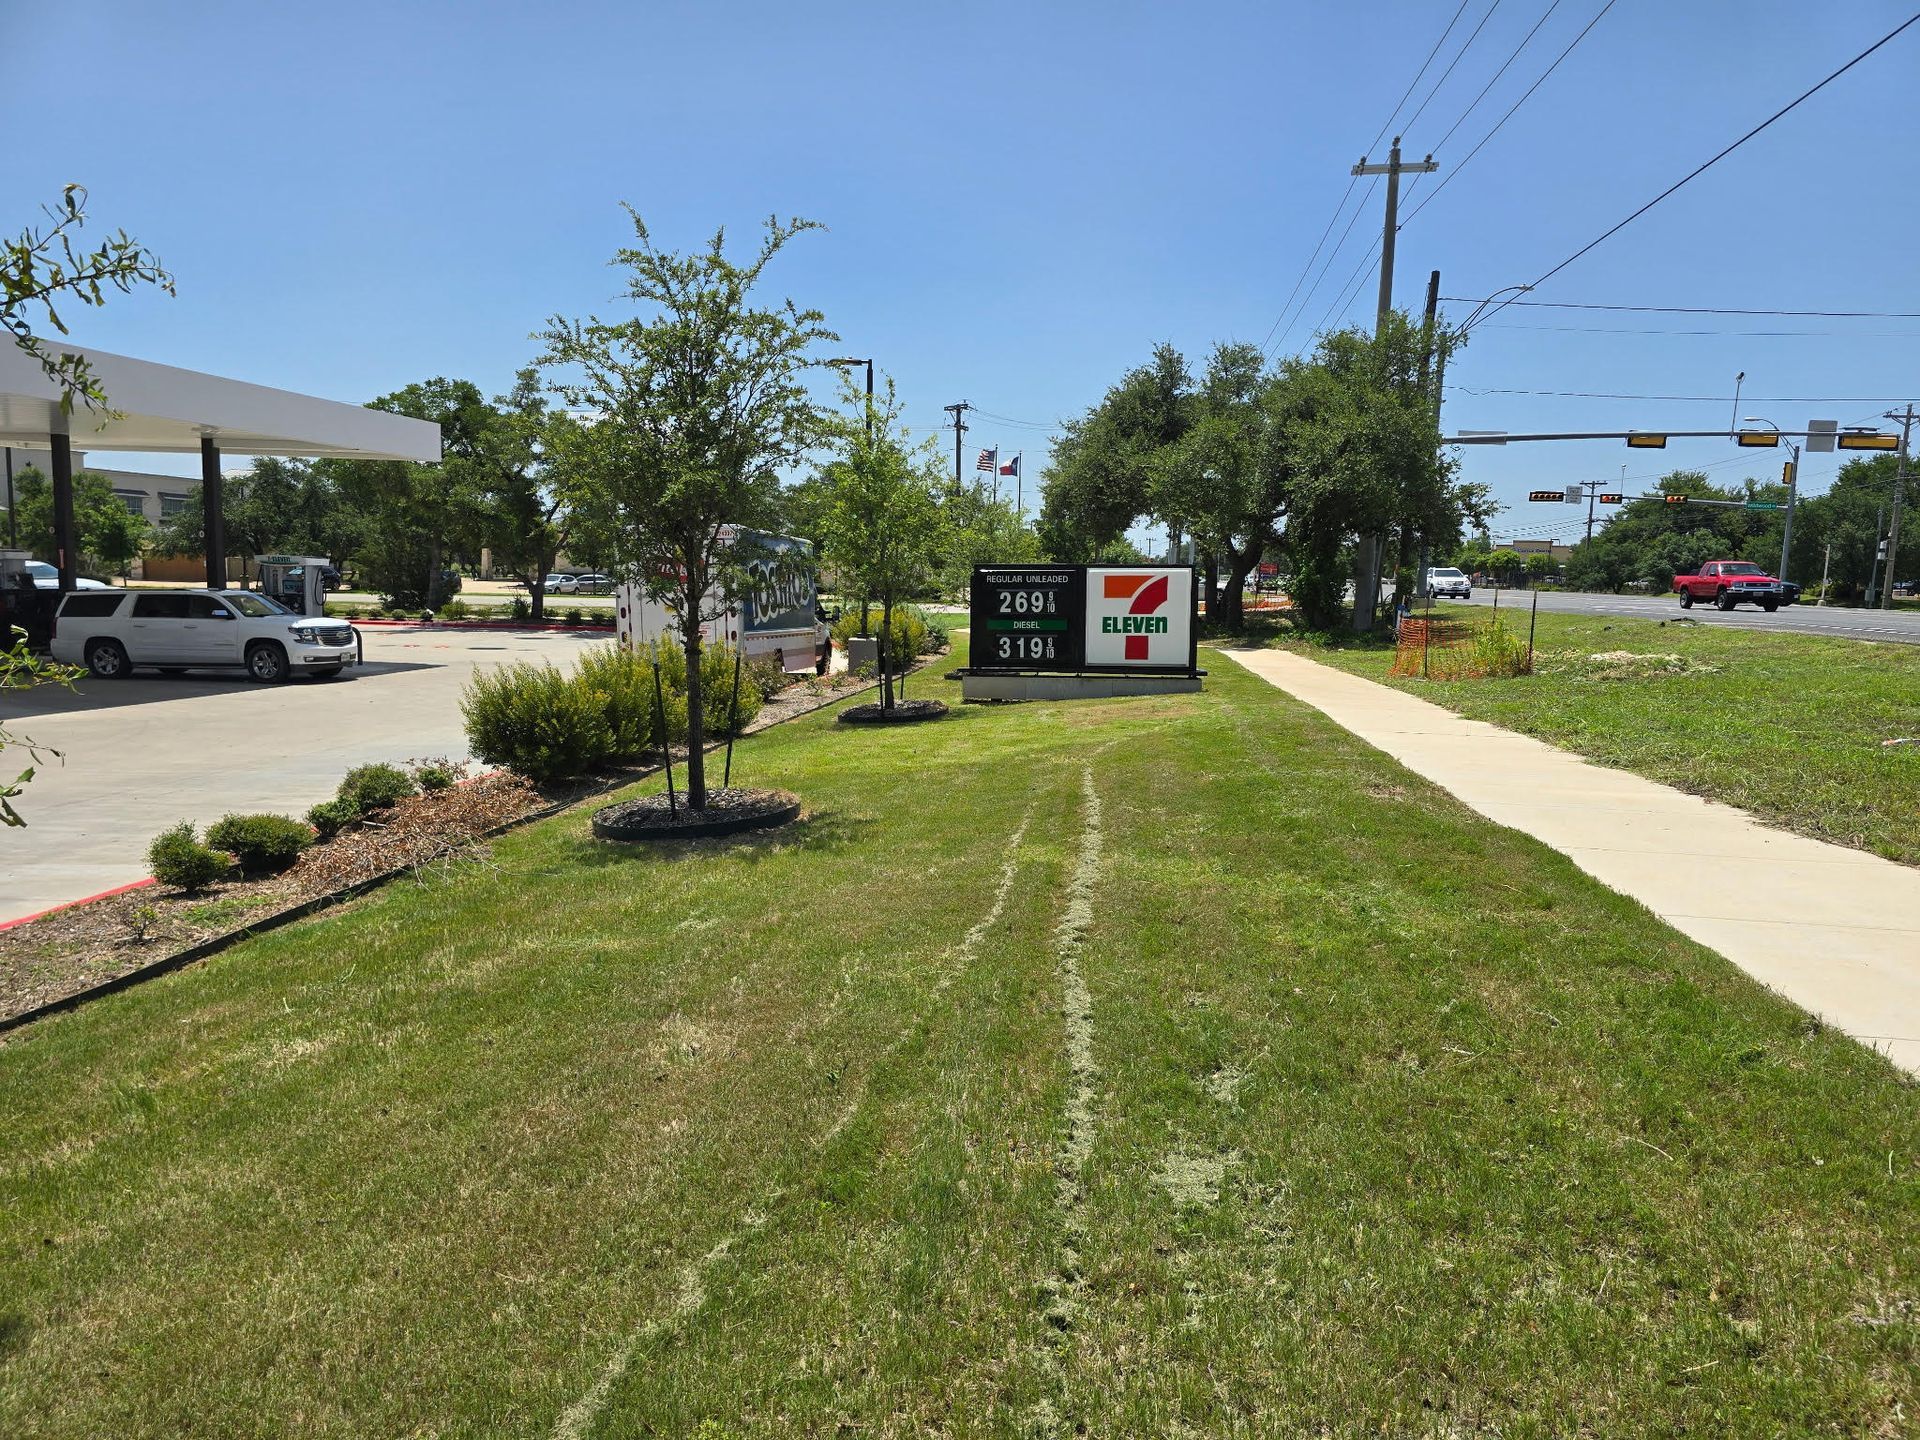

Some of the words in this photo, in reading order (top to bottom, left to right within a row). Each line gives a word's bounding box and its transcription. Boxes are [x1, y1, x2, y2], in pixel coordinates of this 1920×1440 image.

[986, 575, 1023, 583] REGULAR
[1026, 575, 1069, 583] UNLEADED
[999, 591, 1044, 613] 269
[1013, 620, 1041, 629] DIESEL
[1103, 575, 1169, 660] 7
[998, 637, 1043, 659] 319
